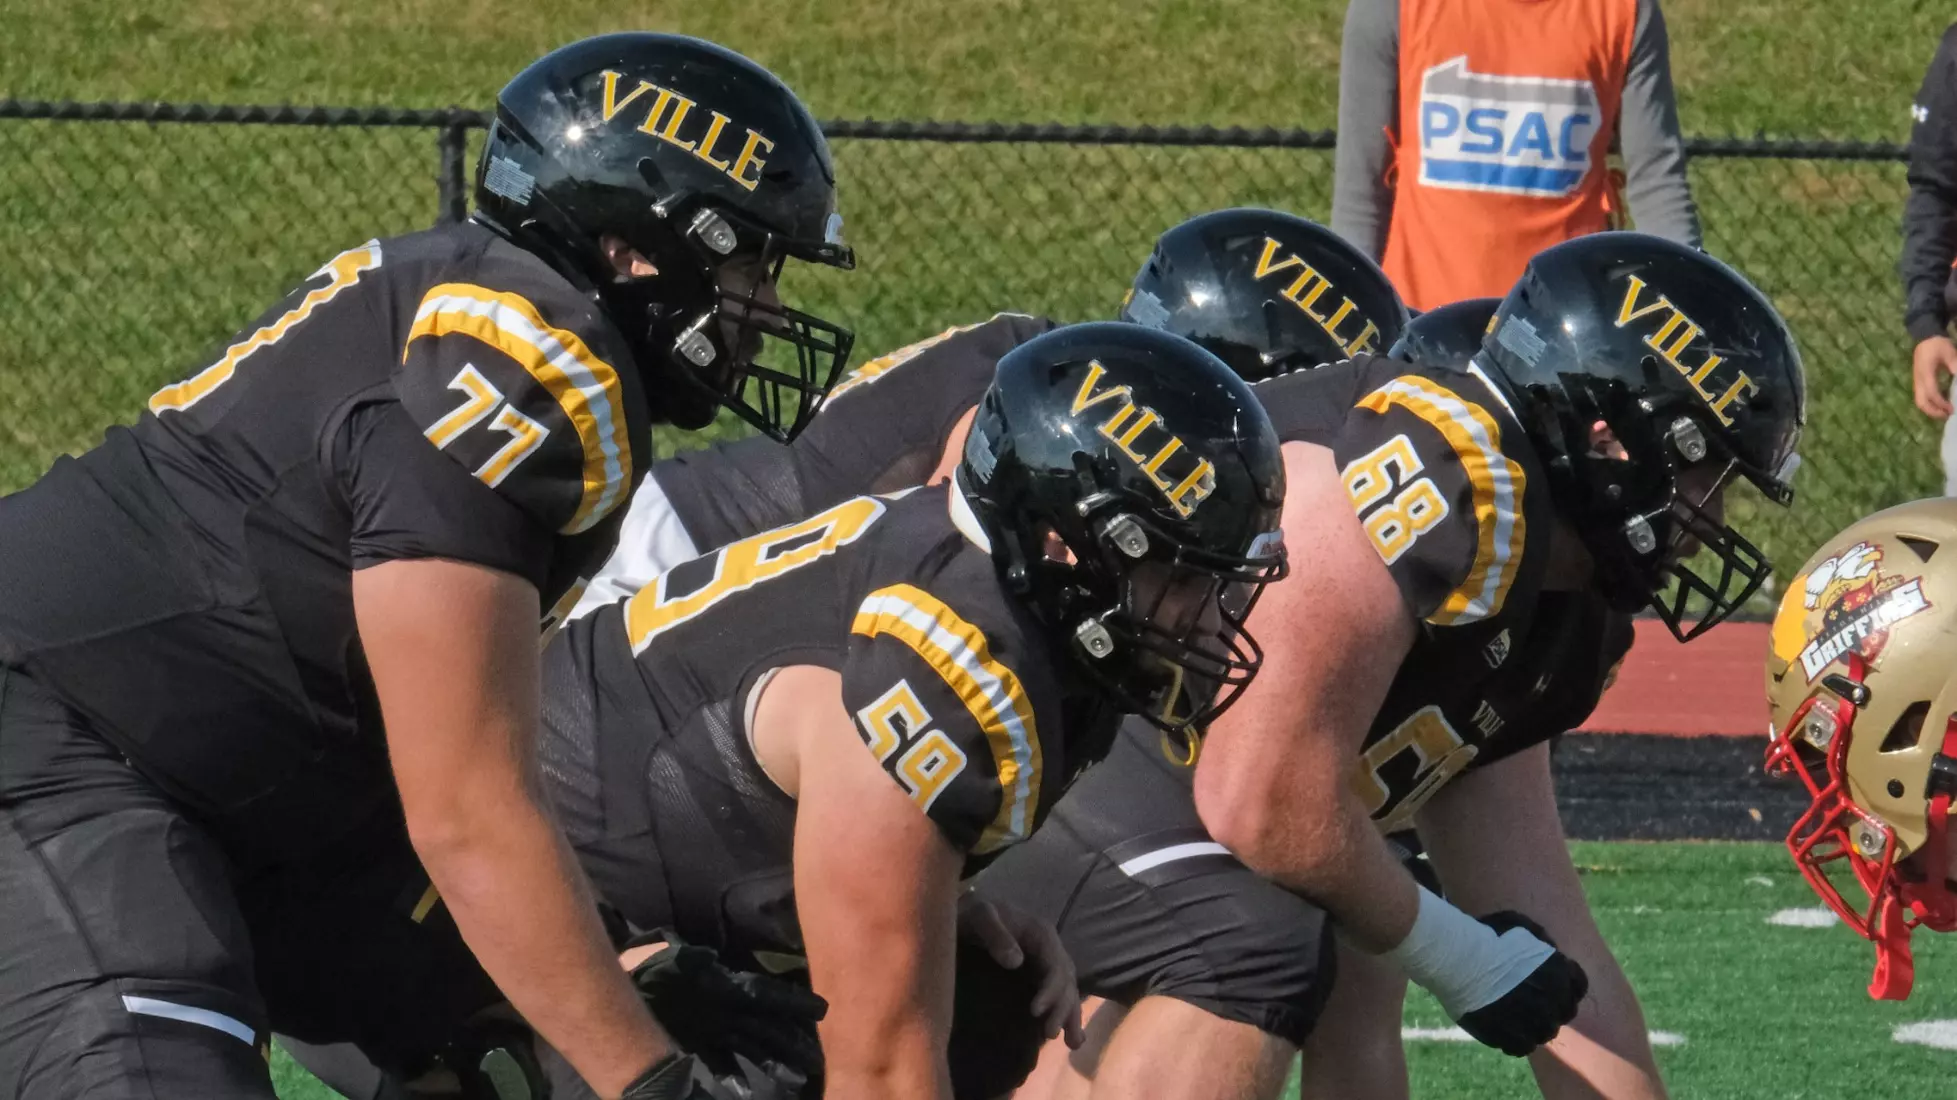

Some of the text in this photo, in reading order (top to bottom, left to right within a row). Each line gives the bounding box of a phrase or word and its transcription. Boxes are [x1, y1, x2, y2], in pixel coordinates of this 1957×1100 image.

[600, 69, 775, 192] VILLE
[1422, 101, 1592, 162] PSAC
[1614, 274, 1760, 428] VILLE
[423, 362, 551, 489] 77
[1070, 359, 1216, 520] VILLE
[1340, 433, 1450, 566] 68
[857, 678, 968, 815] 59
